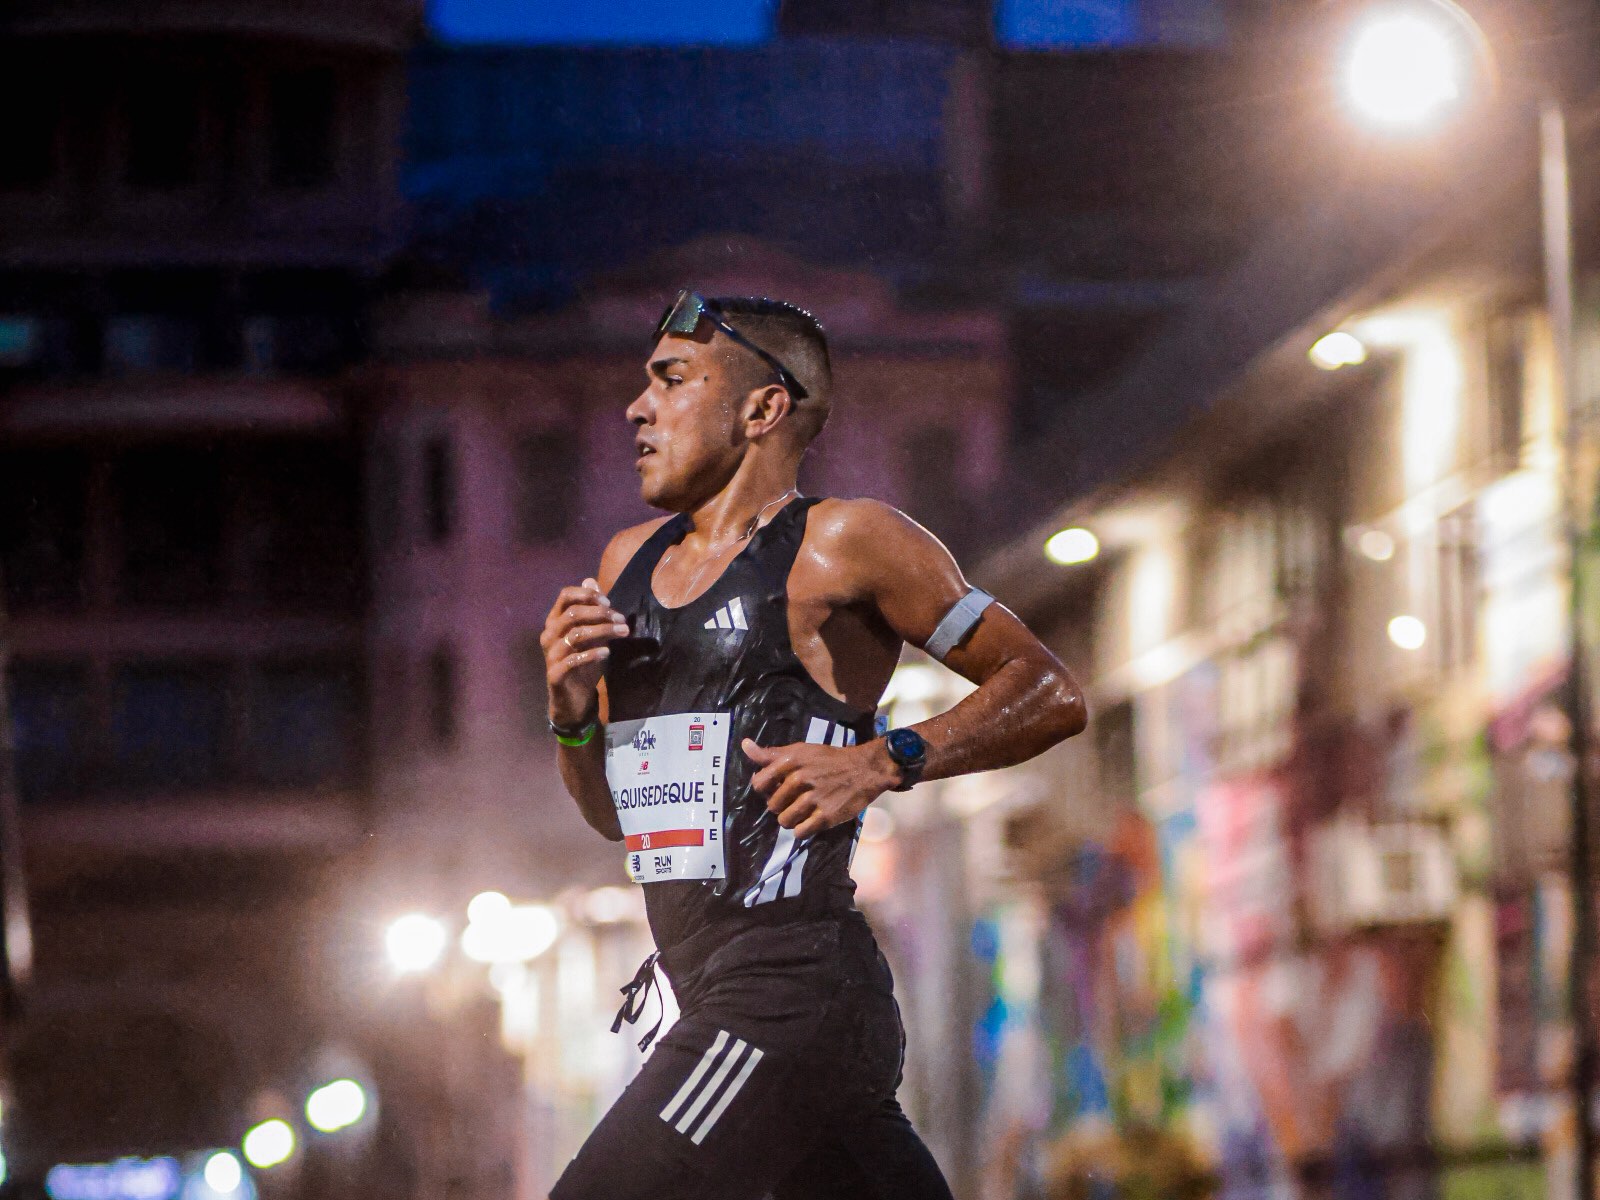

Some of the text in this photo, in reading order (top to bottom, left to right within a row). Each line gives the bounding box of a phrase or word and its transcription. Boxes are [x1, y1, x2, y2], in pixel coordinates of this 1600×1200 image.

[709, 756, 721, 840] ELITE
[641, 834, 651, 849] 20
[654, 855, 672, 868] RUN
[655, 867, 672, 875] SPORTS
